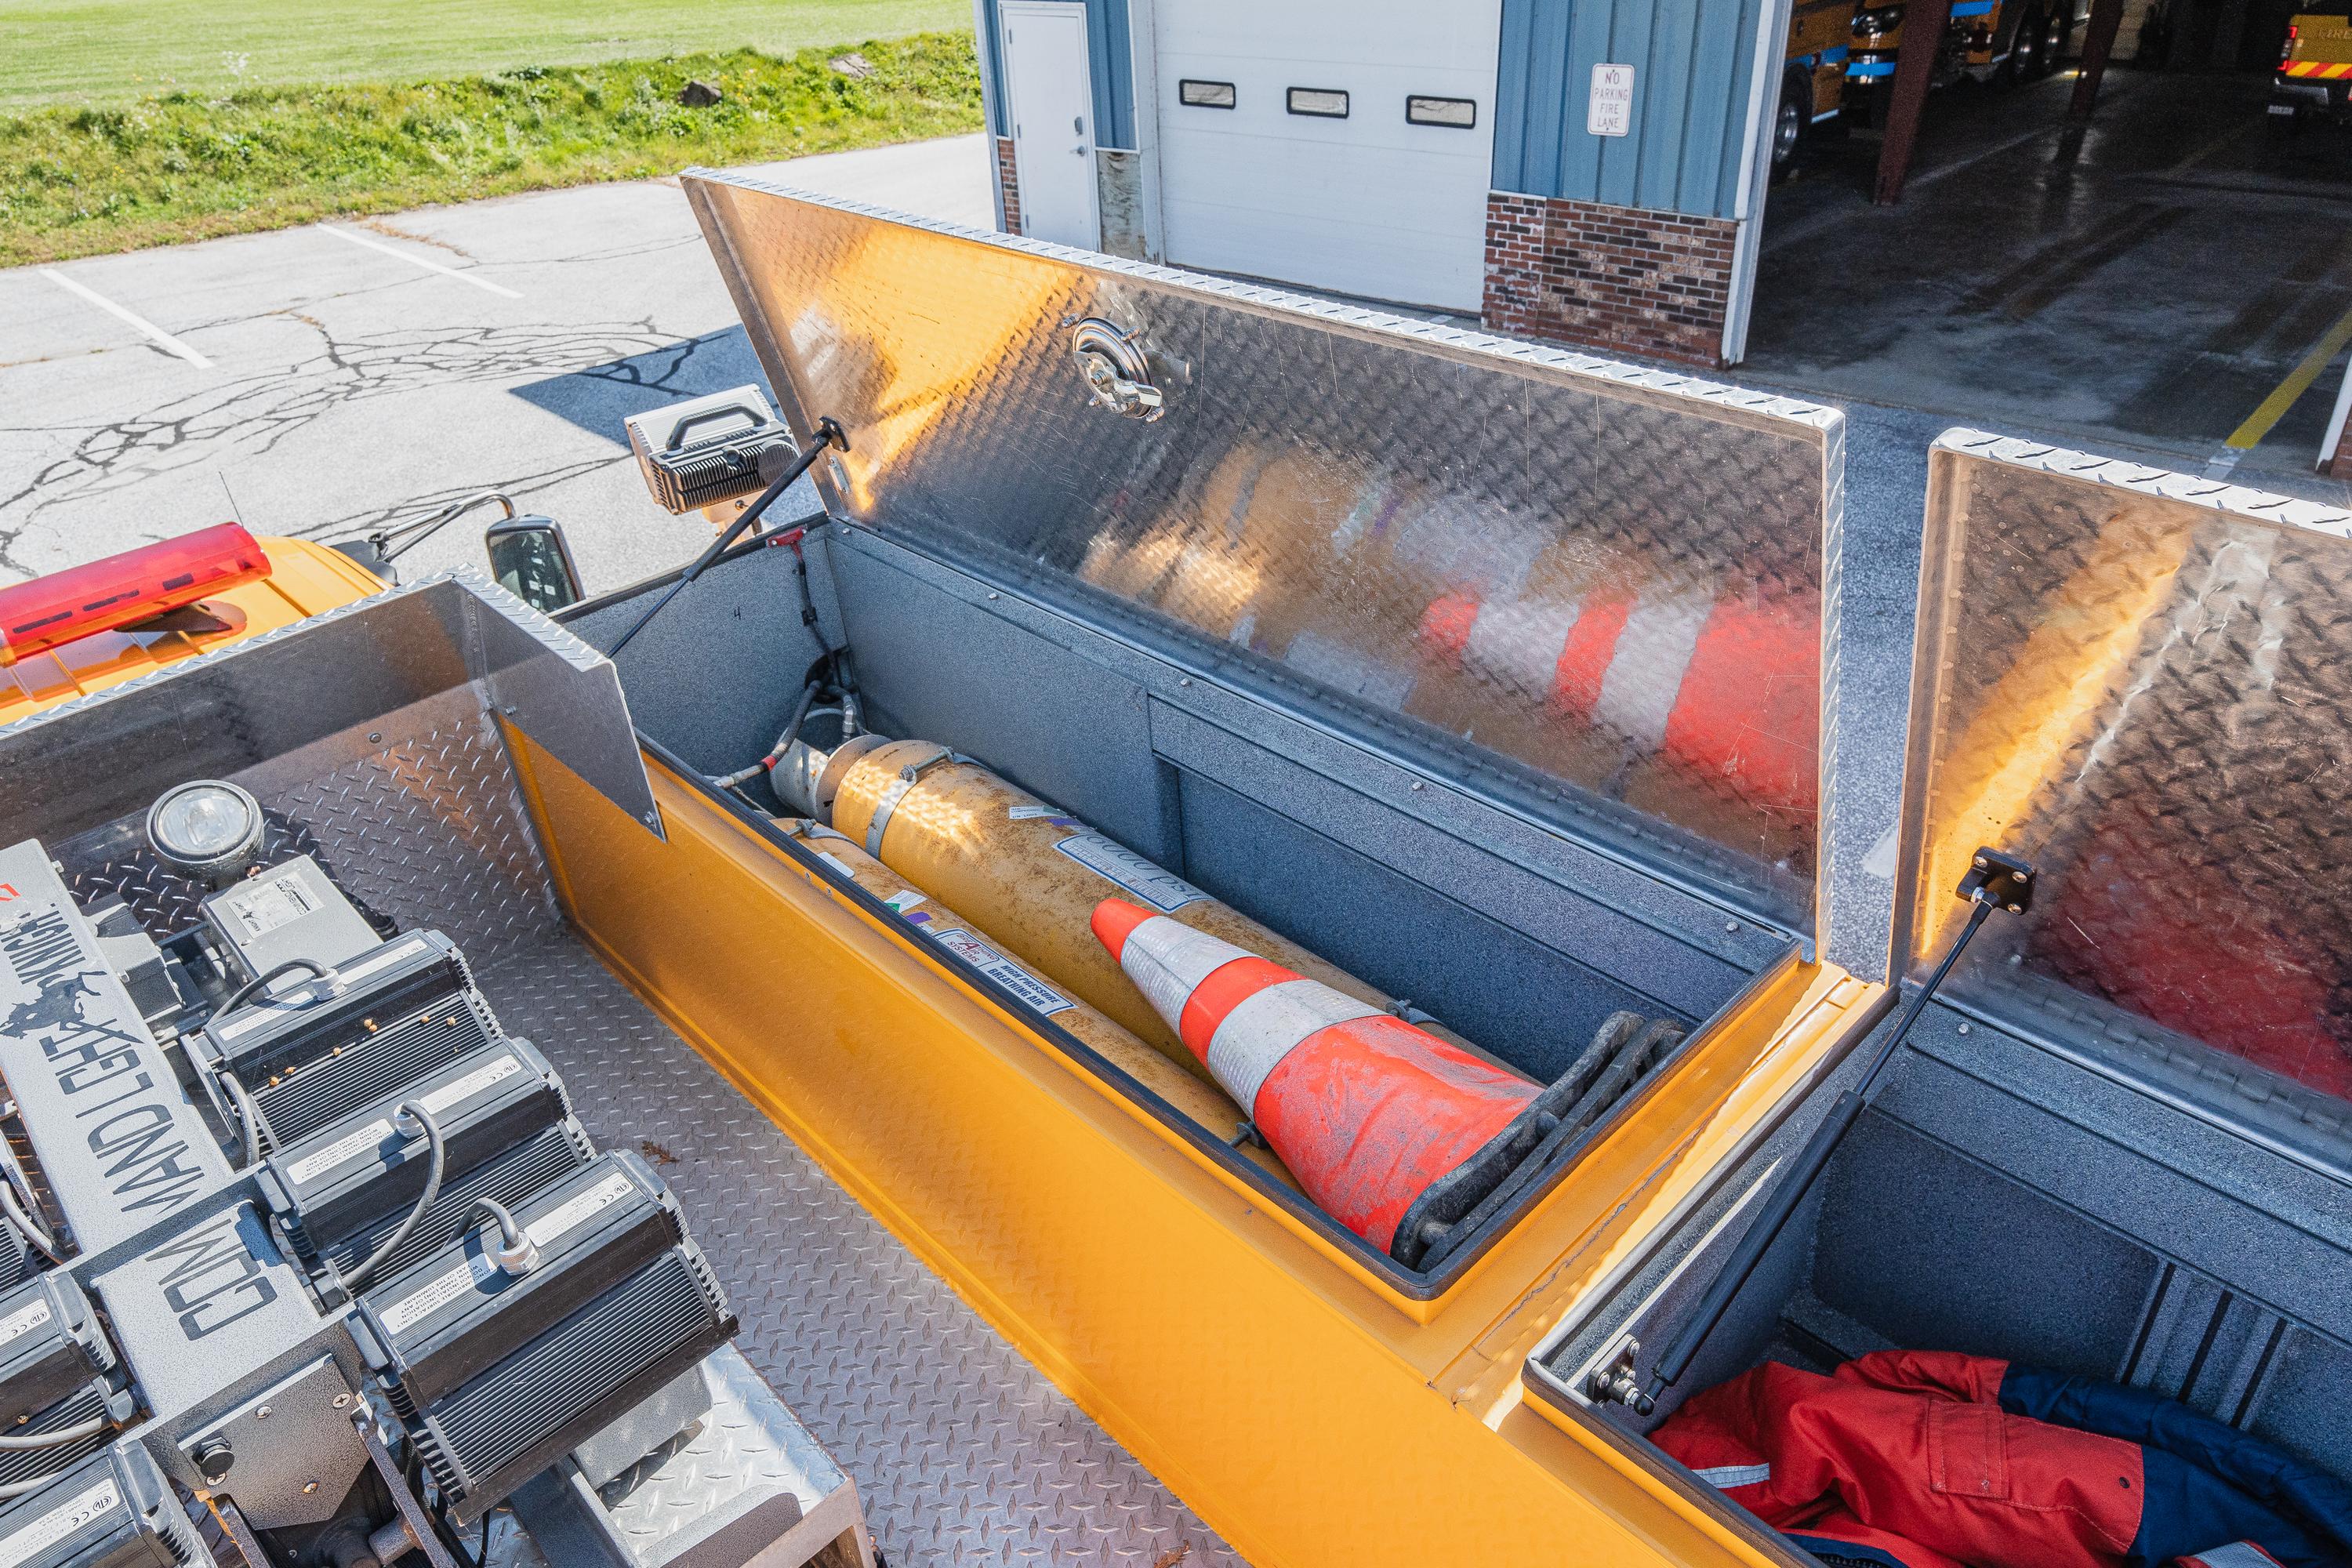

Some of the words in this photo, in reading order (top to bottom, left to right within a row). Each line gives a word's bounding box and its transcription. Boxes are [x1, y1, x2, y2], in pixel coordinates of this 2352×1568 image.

[1606, 72, 1620, 85] NO
[1594, 88, 1628, 101] PARKING
[1600, 103, 1619, 114] FIRE
[1598, 118, 1619, 128] LANE
[734, 606, 741, 620] 4
[0, 903, 86, 985] KNIGH
[947, 941, 980, 963] SYSTEMS
[988, 968, 1029, 997] BREATHING
[1026, 994, 1046, 1007] AIR
[1000, 964, 1022, 979] HIGH
[1021, 977, 1061, 1004] PRESSURE
[459, 1274, 471, 1283] NOT
[403, 1286, 434, 1306] LUMINAIRE
[400, 1304, 414, 1314] ANY
[401, 1296, 436, 1318] INSULATION
[414, 1299, 441, 1316] SURFACE
[396, 1316, 412, 1327] ONLY
[71, 1511, 89, 1526] CE
